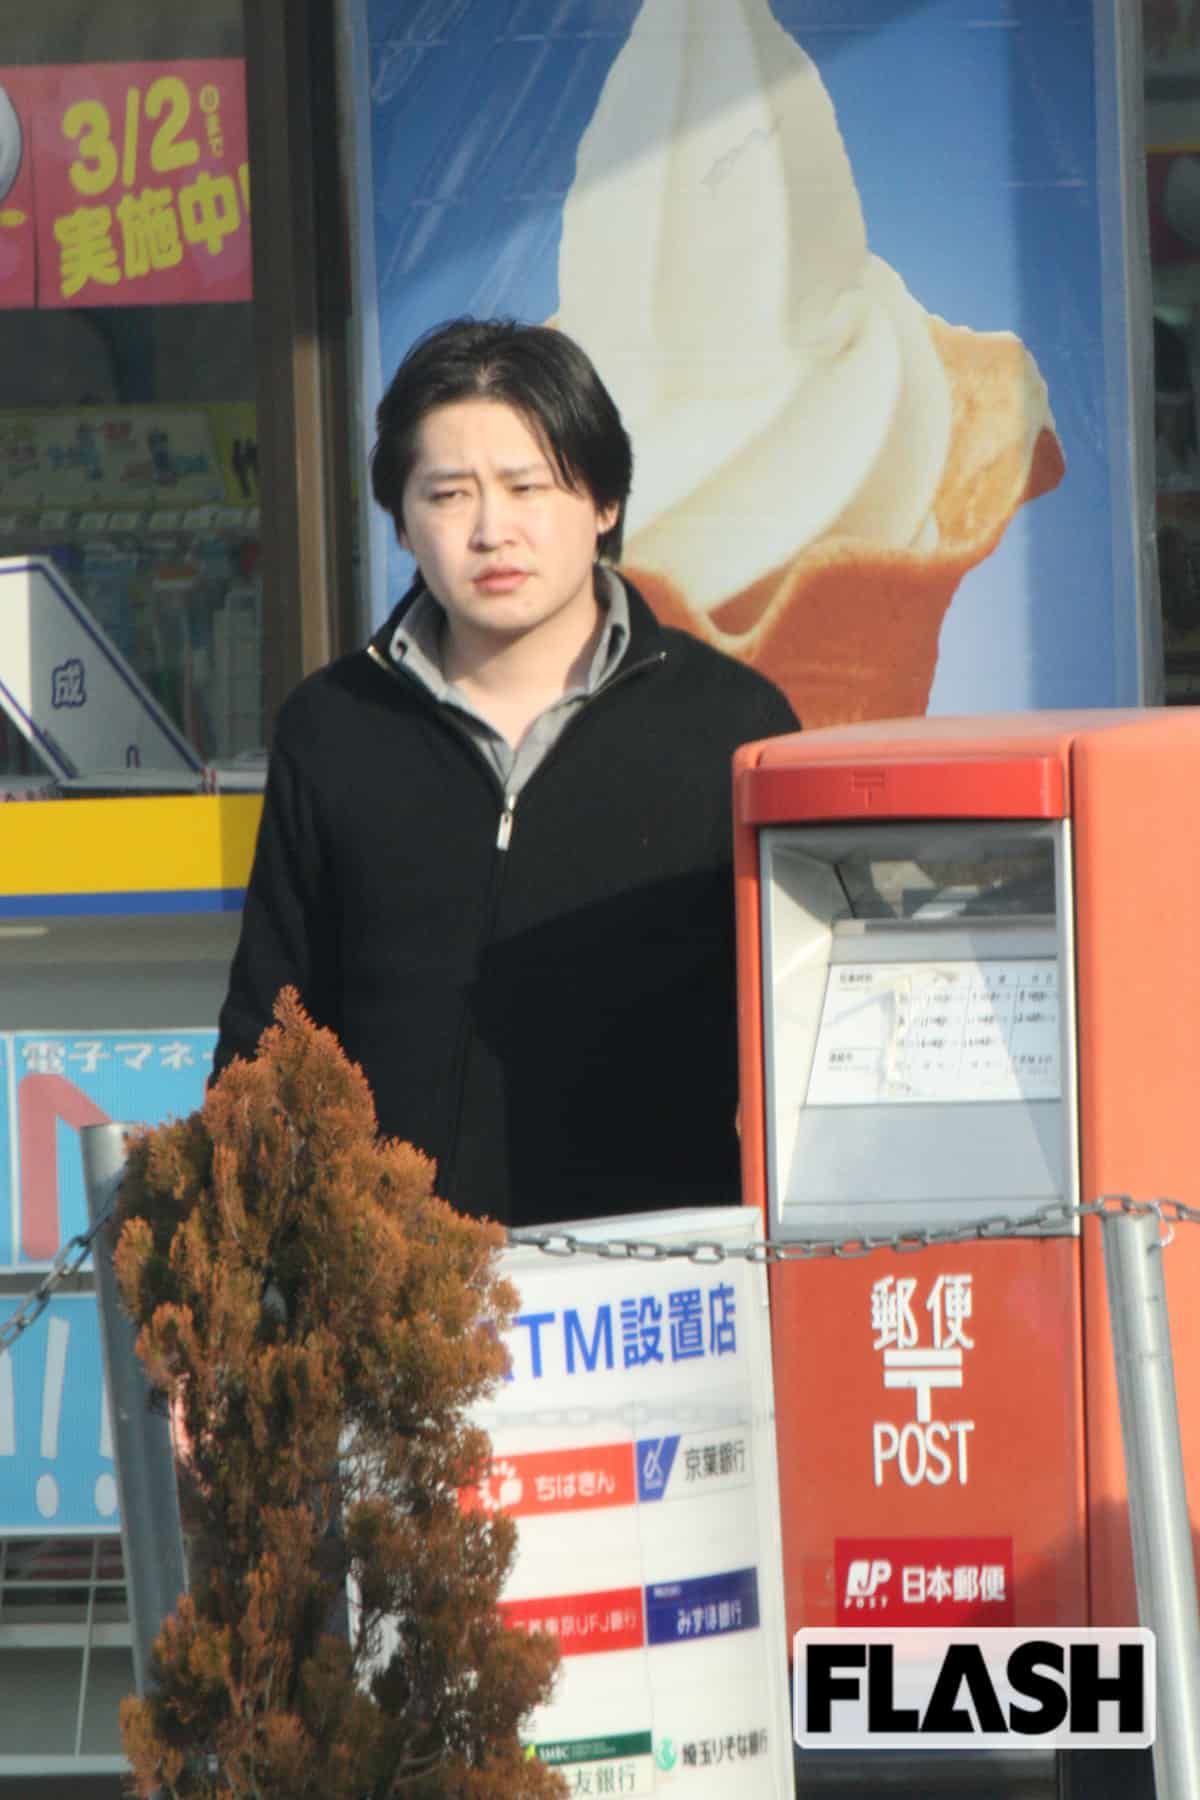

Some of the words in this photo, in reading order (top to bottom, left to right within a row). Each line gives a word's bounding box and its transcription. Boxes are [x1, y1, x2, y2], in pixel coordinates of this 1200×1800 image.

[62, 76, 200, 196] 3/2
[22, 1040, 214, 1074] 電子マネ
[478, 1282, 737, 1382] TM設置店
[870, 1273, 975, 1351] 郵便
[872, 1420, 975, 1486] POST
[902, 1564, 1006, 1604] 日本郵便
